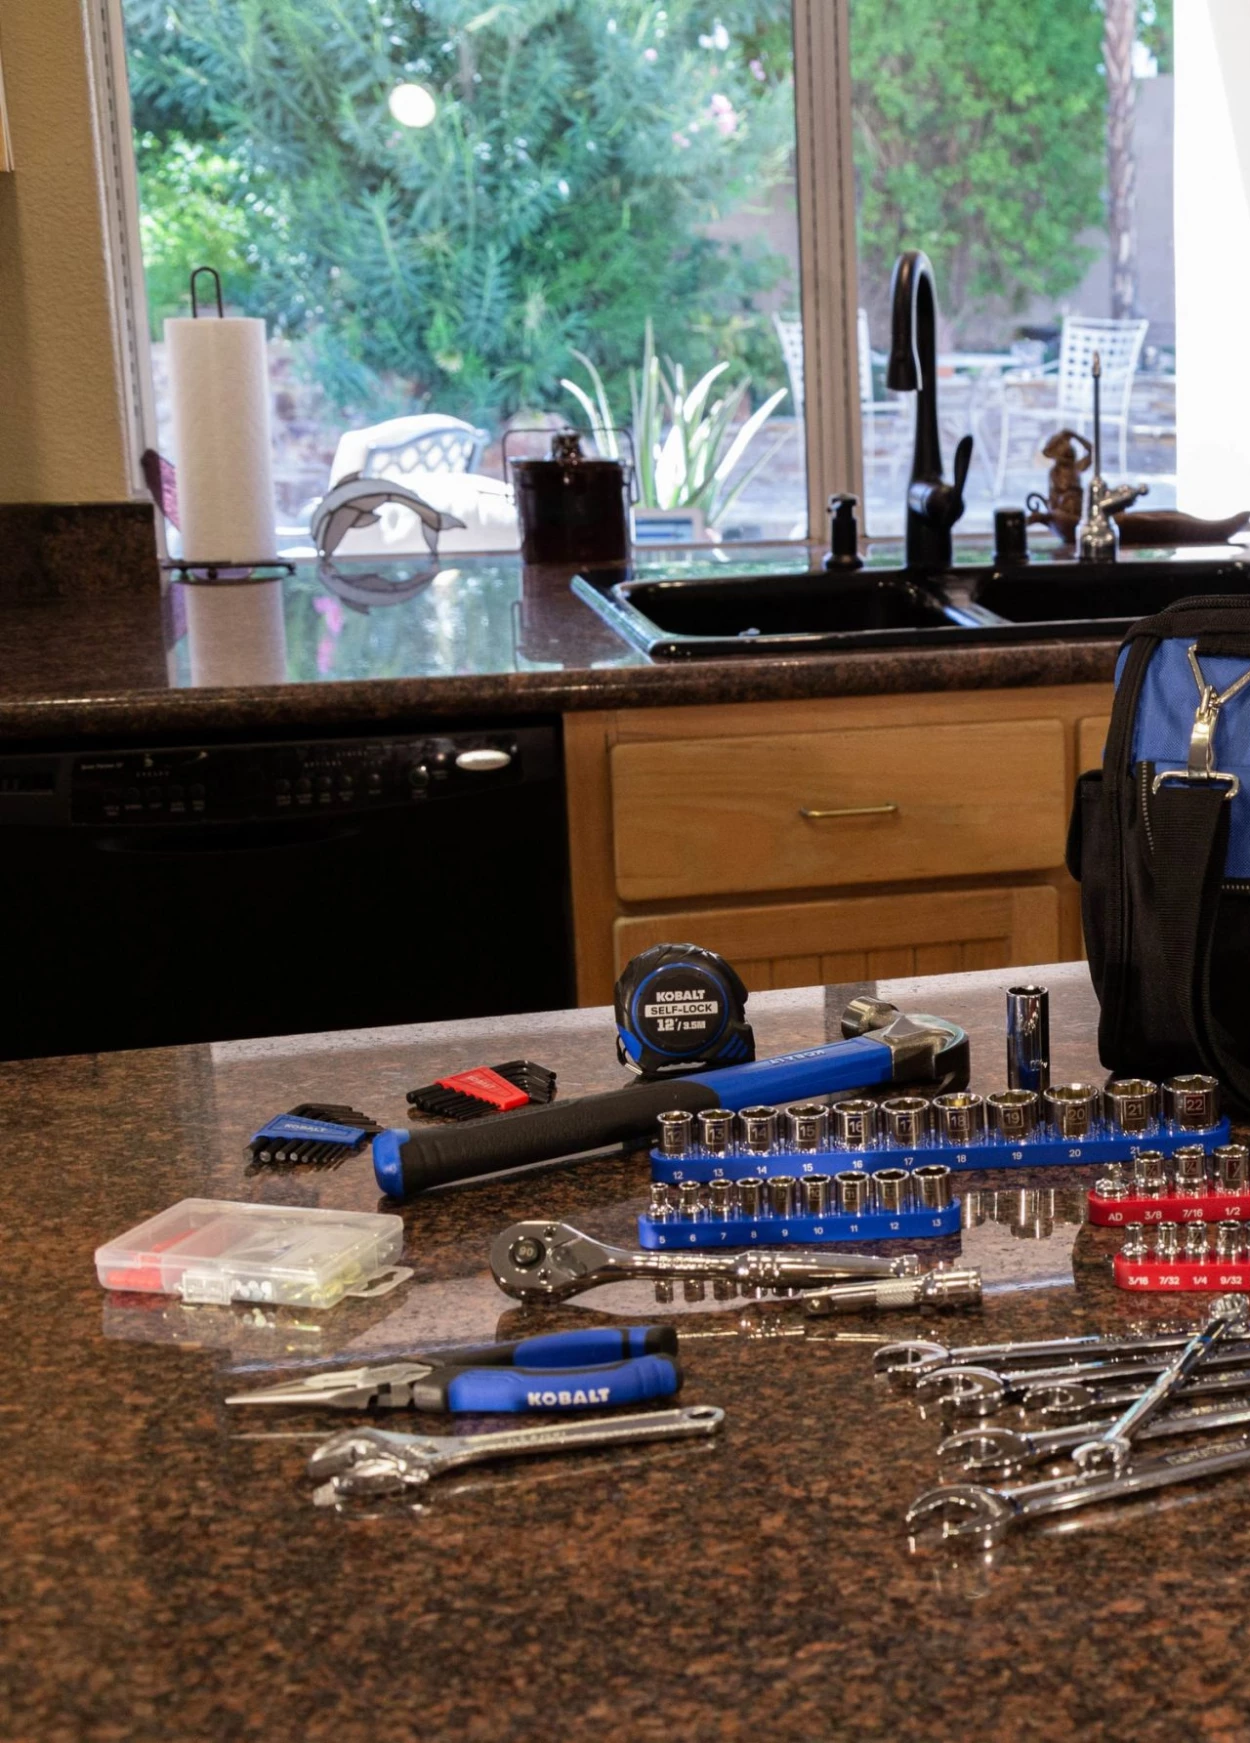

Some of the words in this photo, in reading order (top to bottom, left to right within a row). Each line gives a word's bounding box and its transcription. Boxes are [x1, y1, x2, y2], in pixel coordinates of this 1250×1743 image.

[656, 989, 706, 1003] KOBALT
[650, 1003, 713, 1016] SELF-LOCK
[1128, 1104, 1142, 1116] 21
[1187, 1100, 1203, 1111] 22
[1005, 1112, 1020, 1124] 19
[1068, 1108, 1085, 1120] 20
[850, 1120, 863, 1133] 16
[900, 1120, 914, 1131] 17
[951, 1115, 966, 1127] 18
[709, 1128, 724, 1140] 13
[752, 1128, 766, 1140] 14
[800, 1125, 815, 1137] 15
[673, 1171, 683, 1180] 12
[713, 1168, 724, 1177] 13
[756, 1165, 767, 1174] 14
[802, 1163, 813, 1172] 15
[852, 1160, 863, 1169] 16
[904, 1157, 913, 1166] 17
[956, 1154, 967, 1163] 18
[1012, 1152, 1023, 1161] 19
[1069, 1149, 1081, 1158] 20
[1108, 1213, 1123, 1222] AD
[1144, 1211, 1162, 1220] 3/8
[1182, 1209, 1203, 1218] 7/16
[1225, 1206, 1241, 1216] 1/2
[659, 1235, 666, 1244] 5
[689, 1232, 696, 1242] 6
[721, 1231, 727, 1240] 7
[750, 1229, 757, 1239] 8
[782, 1228, 789, 1237] 9
[813, 1226, 823, 1236] 10
[850, 1224, 858, 1233] 11
[890, 1222, 899, 1231] 12
[1128, 1275, 1149, 1285] 3/16
[1159, 1275, 1180, 1285] 7/32
[1192, 1275, 1208, 1285] 1/4
[1220, 1275, 1242, 1285] 9/32
[527, 1388, 610, 1406] KOBALT
